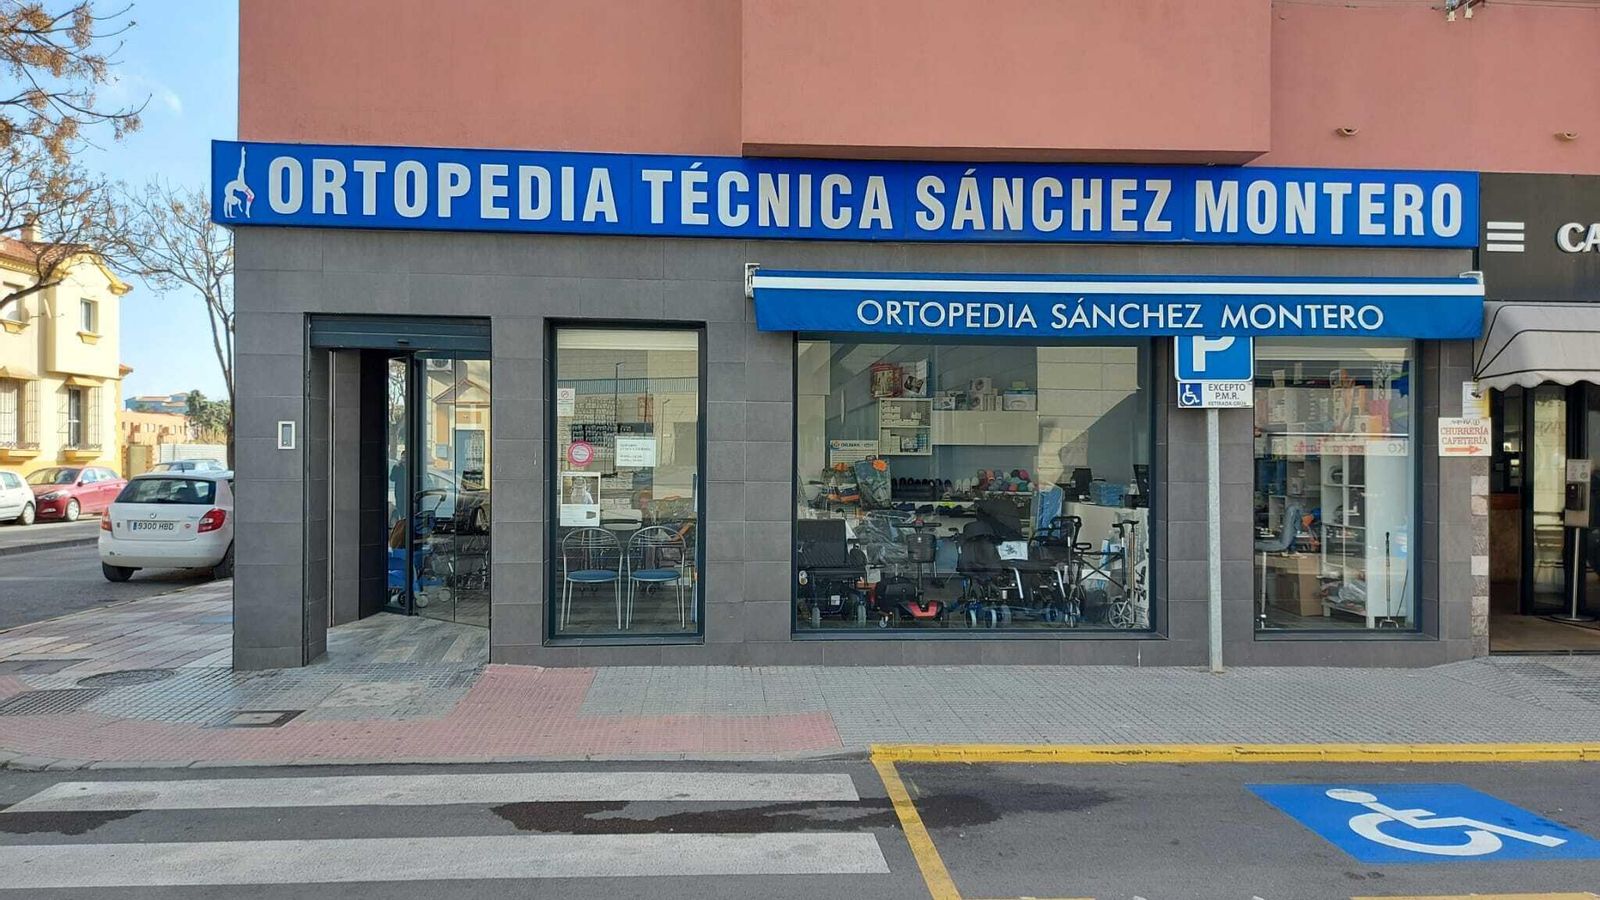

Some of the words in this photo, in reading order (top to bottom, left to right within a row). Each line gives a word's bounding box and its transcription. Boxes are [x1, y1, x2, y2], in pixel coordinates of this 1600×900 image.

[268, 156, 619, 223] ORTOPEDIA
[641, 162, 894, 229] TÉCNICA
[915, 168, 1173, 233] SÁNCHEZ
[1194, 179, 1463, 238] MONTERO
[856, 298, 1038, 329] ORTOPEDIA
[1050, 297, 1204, 329] SÁNCHEZ
[1220, 303, 1384, 331] MONTERO
[1192, 336, 1235, 372] P
[1208, 383, 1246, 391] EXCEPTO
[1215, 392, 1240, 400] P.M.R.
[1440, 426, 1489, 435] CHURRERÍA
[1441, 436, 1488, 445] CAFETERÍA
